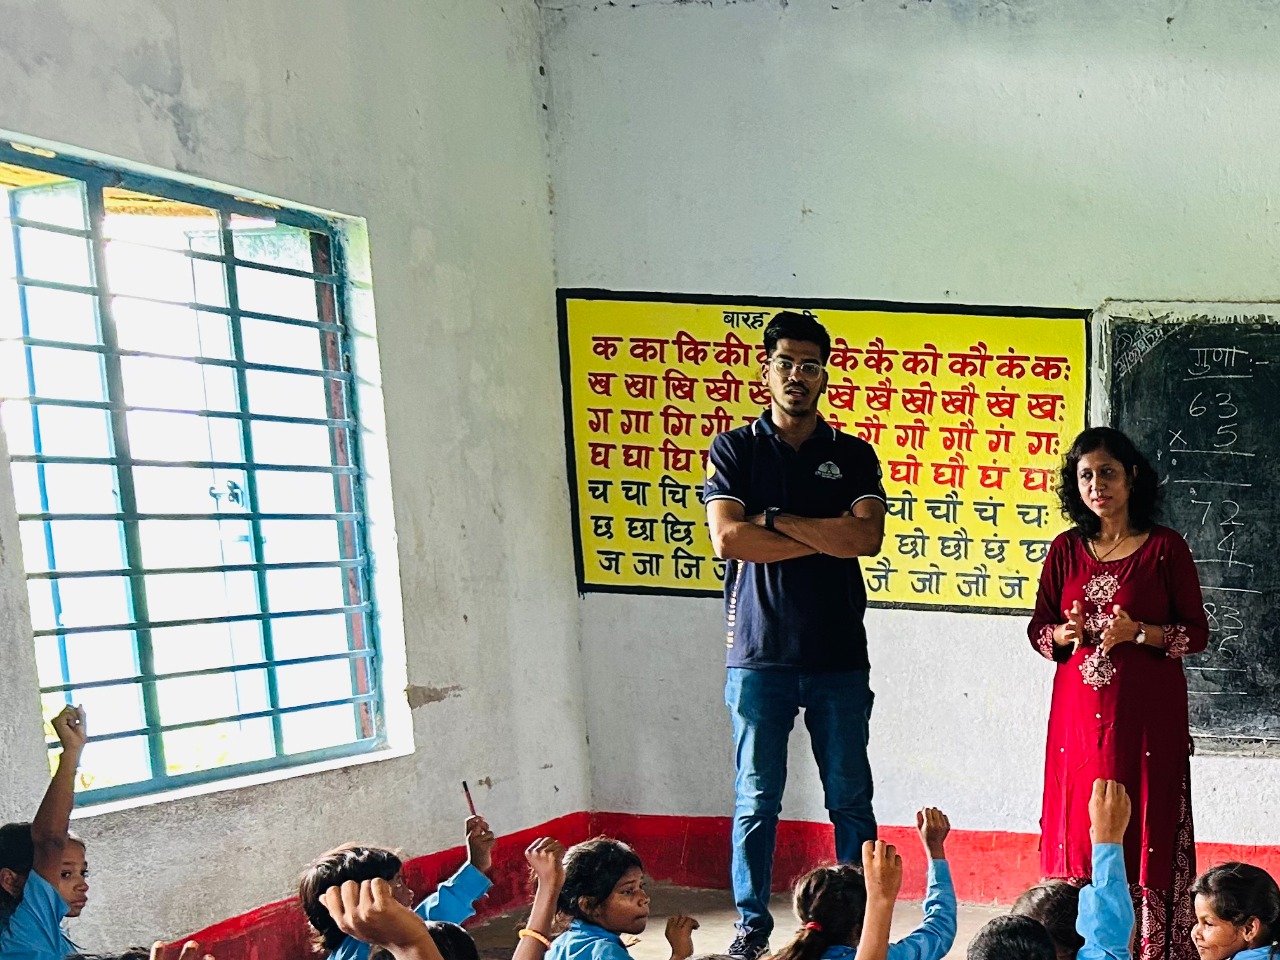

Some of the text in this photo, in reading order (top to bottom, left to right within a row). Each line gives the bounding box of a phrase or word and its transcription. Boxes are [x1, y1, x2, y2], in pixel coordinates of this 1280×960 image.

[723, 311, 770, 329] बारह
[592, 336, 623, 360] क
[629, 338, 669, 363] का
[672, 330, 711, 365] कि
[713, 331, 752, 367] की
[829, 337, 863, 372] के
[863, 337, 899, 375] कै
[902, 343, 943, 377] को
[948, 341, 994, 379] कौ
[996, 347, 1030, 380] कं
[588, 372, 618, 397] ख
[624, 373, 658, 399] खा
[663, 368, 699, 403] खि
[703, 370, 744, 404] खी
[827, 377, 860, 412] खे
[865, 377, 898, 412] खै
[901, 381, 937, 416] खो
[941, 382, 980, 417] खौ
[986, 385, 1021, 419] खं
[587, 408, 614, 435] ग
[620, 408, 654, 436] गा
[660, 405, 697, 437] गि
[895, 418, 930, 450] गो
[939, 418, 979, 452] गौ
[985, 423, 1016, 453] गं
[1213, 423, 1238, 448] 5
[588, 442, 616, 469] घ
[622, 444, 654, 470] घा
[659, 438, 695, 472] घि
[888, 454, 923, 486] घो
[931, 452, 968, 489] घौ
[978, 459, 1010, 490] घं
[588, 480, 613, 503] च
[621, 480, 651, 507] चा
[659, 474, 691, 509] चि
[885, 490, 918, 522] चो
[925, 490, 964, 524] चौ
[973, 496, 1004, 527] चं
[590, 515, 614, 539] छ
[625, 517, 658, 541] छा
[661, 512, 695, 546] छि
[895, 527, 930, 559] छो
[938, 527, 974, 561] छौ
[981, 533, 1010, 563] छं
[1217, 531, 1236, 568] 4
[597, 550, 625, 575] ज
[632, 552, 664, 576] जा
[672, 546, 706, 580] जि
[865, 556, 898, 593] जै
[908, 563, 947, 595] जो
[956, 563, 991, 597] जौ
[999, 569, 1030, 600] जं
